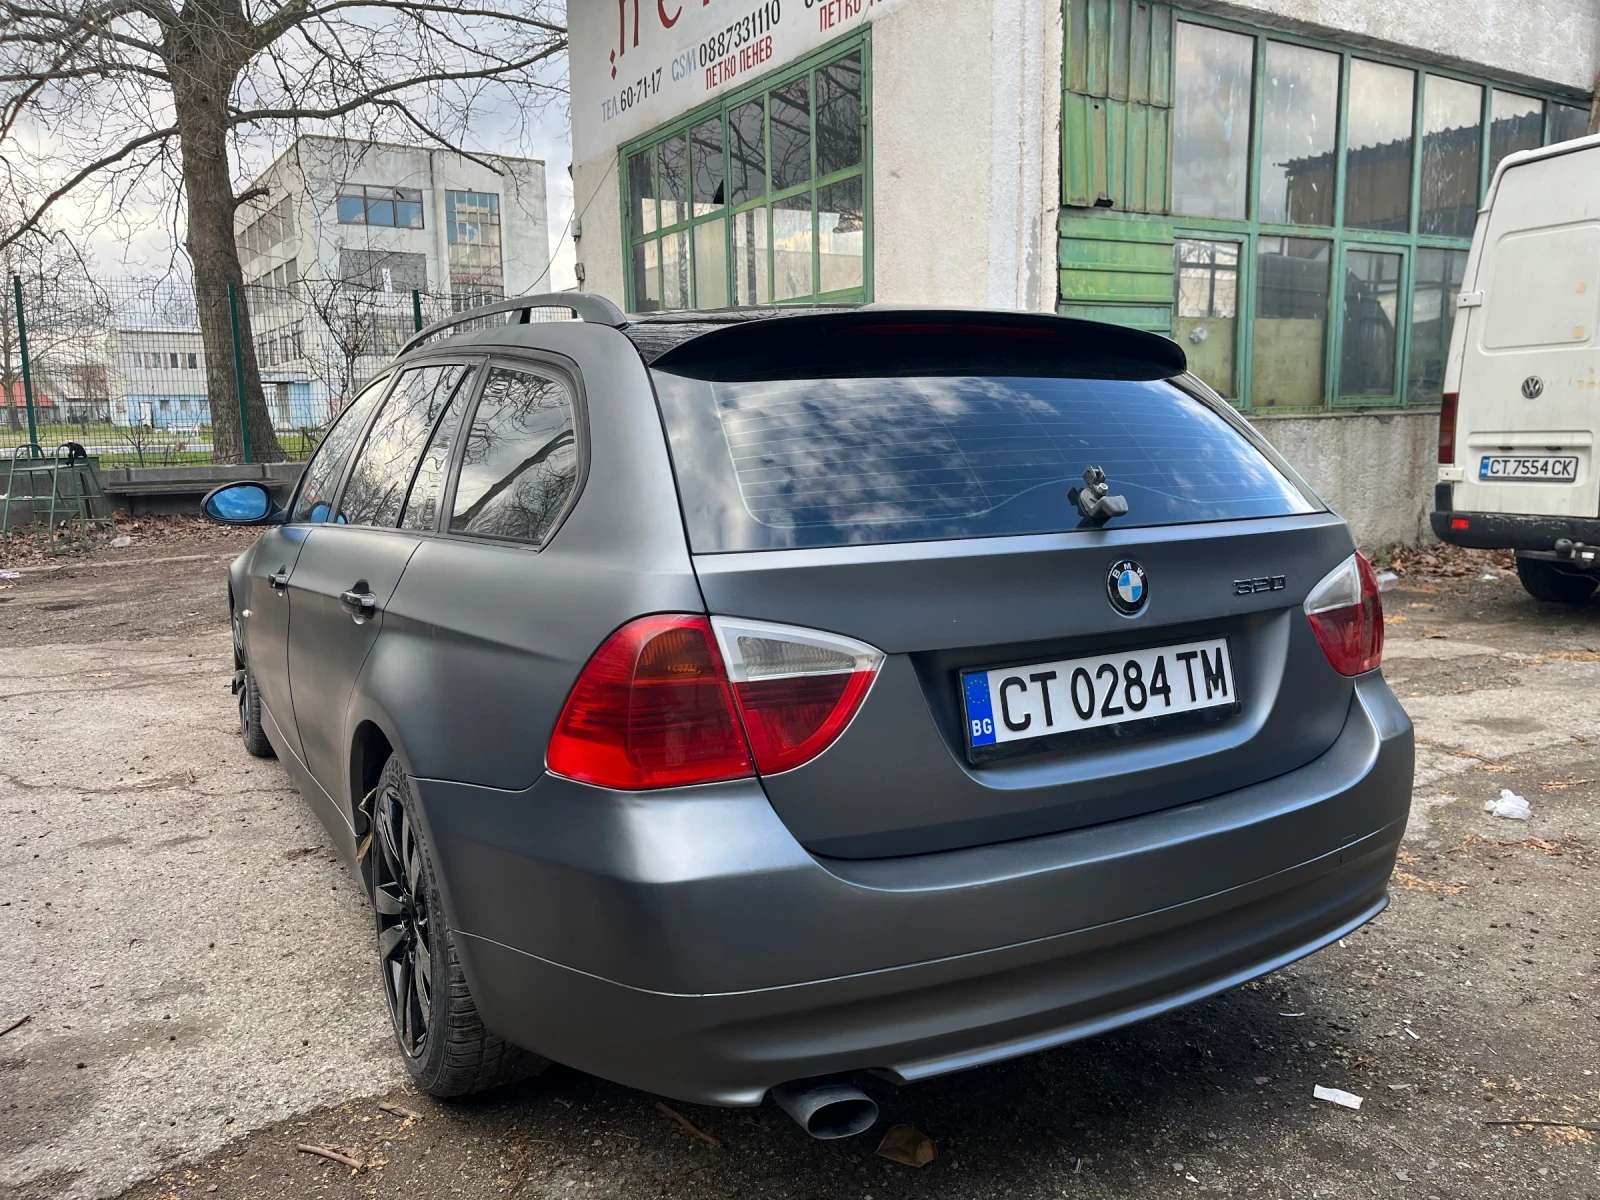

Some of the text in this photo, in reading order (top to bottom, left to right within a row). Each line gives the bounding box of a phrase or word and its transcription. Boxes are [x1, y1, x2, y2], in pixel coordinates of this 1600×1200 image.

[671, 48, 697, 82] GSM
[699, 0, 781, 67] 0887331110
[706, 35, 773, 90] ПЕТКО ПЕНЕВ
[1112, 562, 1144, 579] BMW
[971, 719, 993, 737] BG
[999, 670, 1058, 732] CT
